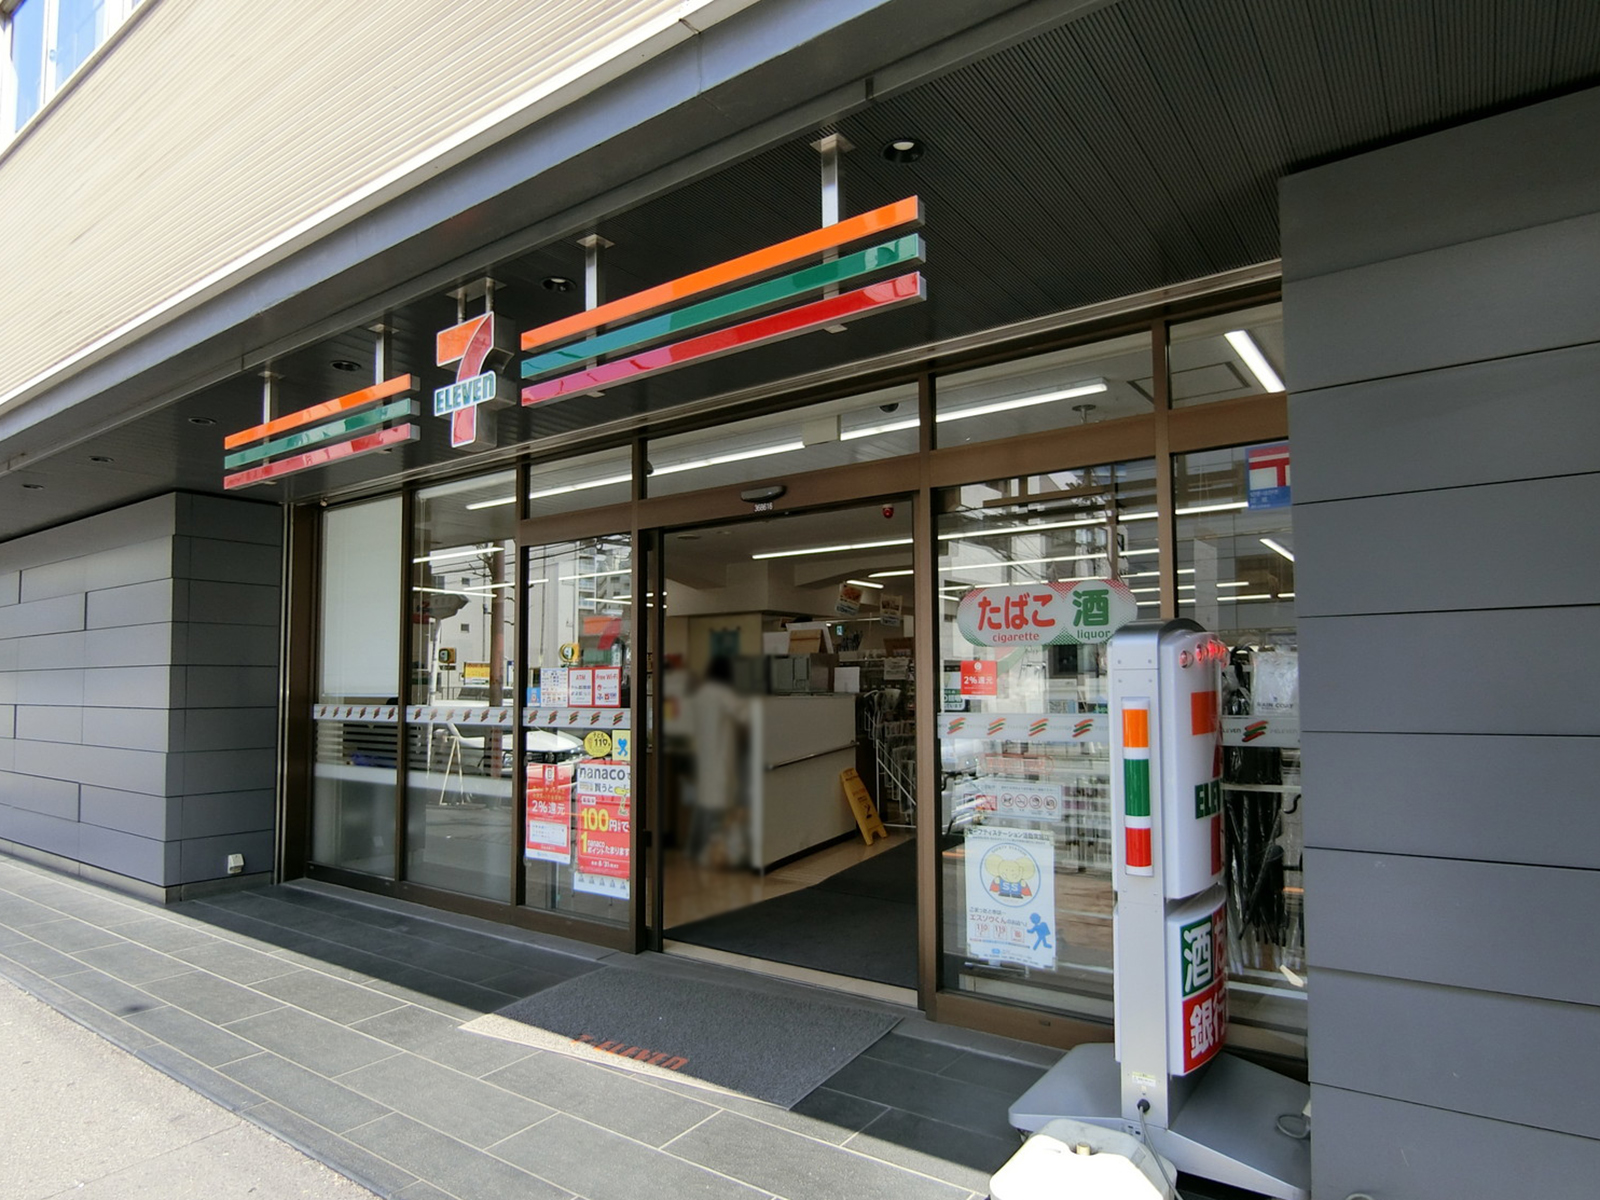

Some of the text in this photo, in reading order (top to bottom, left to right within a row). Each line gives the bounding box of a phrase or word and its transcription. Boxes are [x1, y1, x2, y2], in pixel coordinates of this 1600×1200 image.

[436, 311, 495, 448] 7
[978, 589, 1110, 631] たばこ 酒
[992, 629, 1111, 643] cigarette liquor
[963, 675, 994, 685] 2%還元
[594, 782, 614, 794] 買うと
[532, 799, 566, 816] 2%還元
[1184, 921, 1213, 993] 酒
